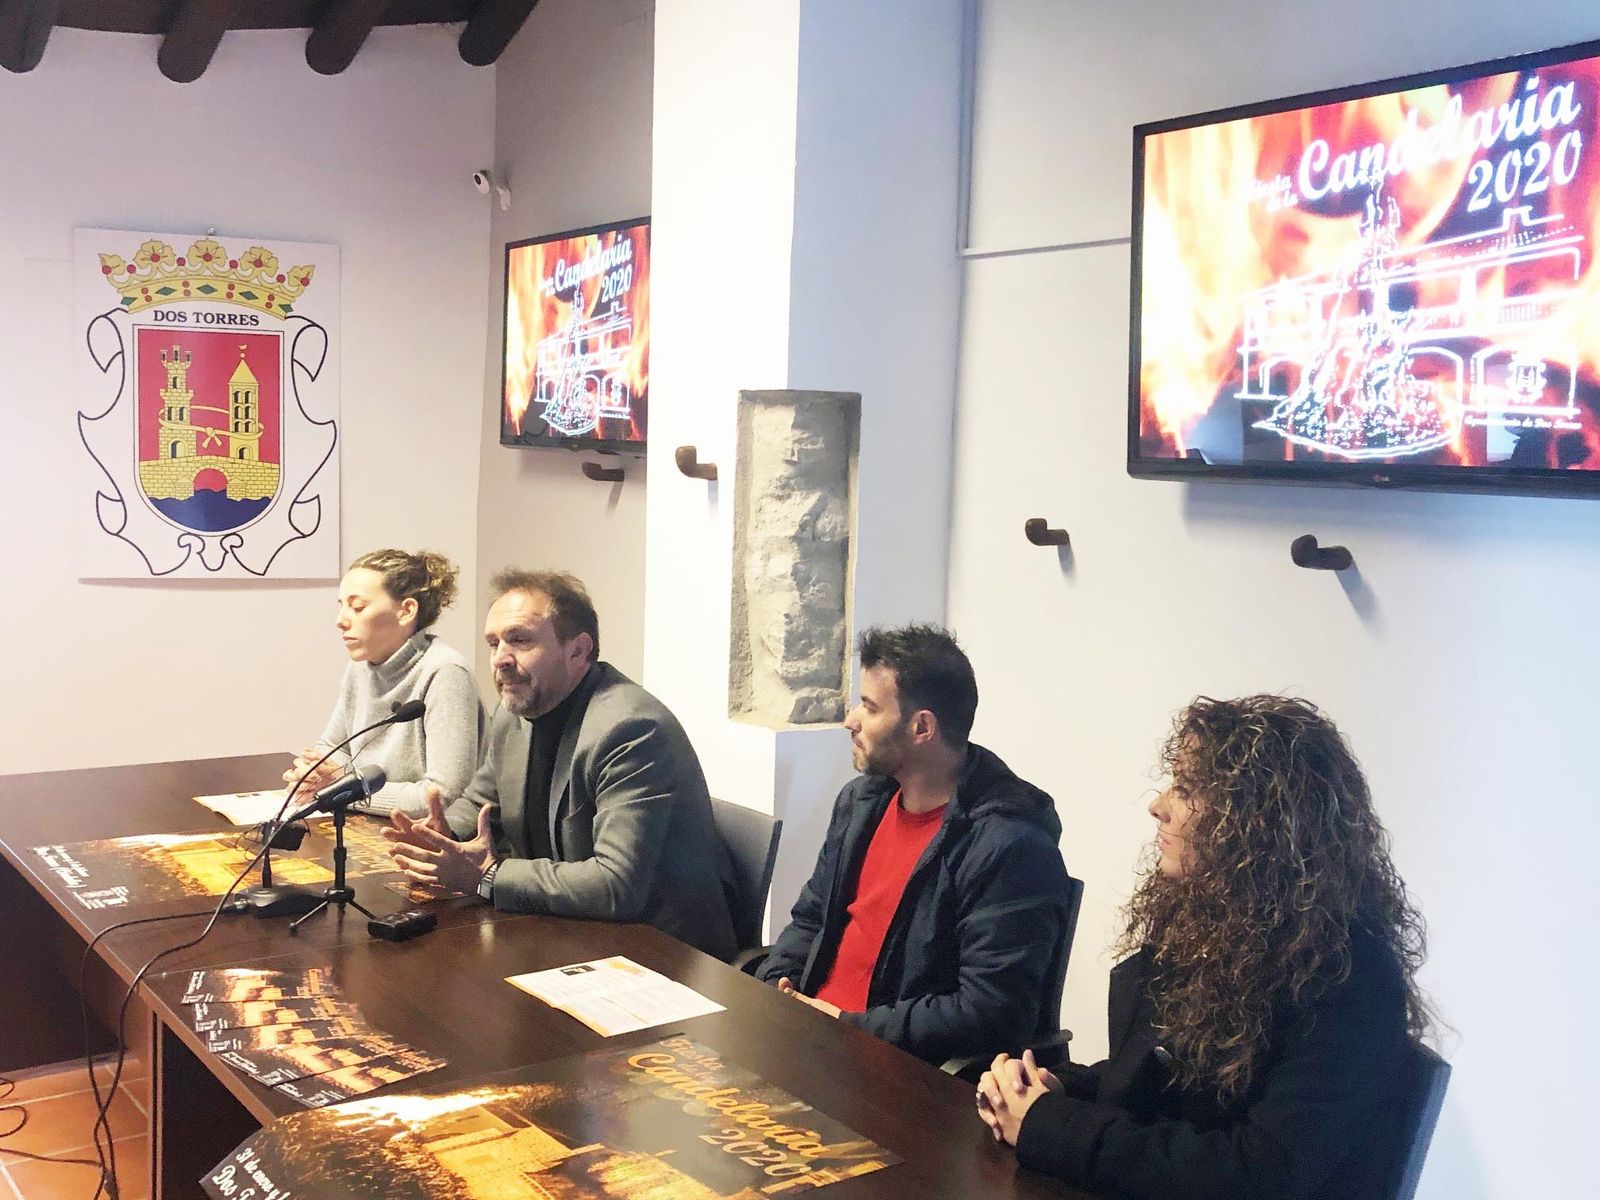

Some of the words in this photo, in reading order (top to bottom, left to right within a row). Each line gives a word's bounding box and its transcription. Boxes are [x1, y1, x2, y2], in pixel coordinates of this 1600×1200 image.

[1298, 76, 1581, 200] Candelaria
[1467, 130, 1583, 213] 2020
[602, 263, 632, 303] 2020
[153, 310, 187, 322] DOS
[193, 312, 259, 326] TORRES
[627, 1053, 829, 1159] Candelaria
[236, 1147, 255, 1164] 31
[243, 1158, 261, 1174] de
[699, 1129, 812, 1177] 2020
[212, 1165, 239, 1197] Dos
